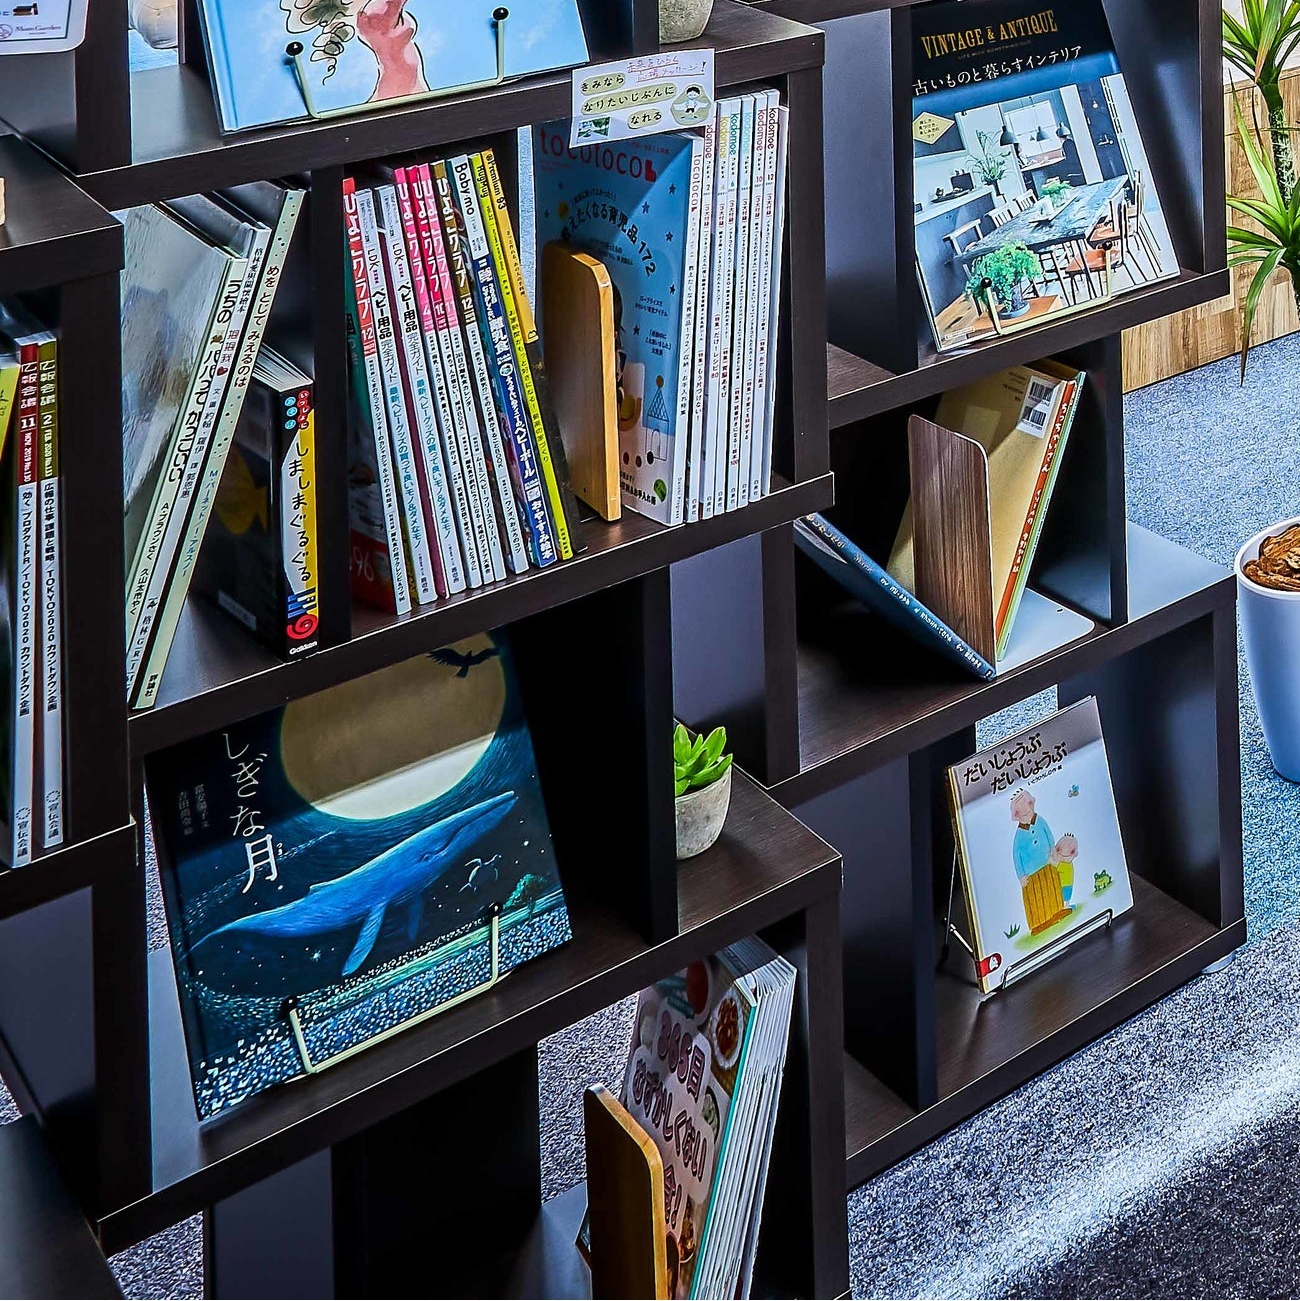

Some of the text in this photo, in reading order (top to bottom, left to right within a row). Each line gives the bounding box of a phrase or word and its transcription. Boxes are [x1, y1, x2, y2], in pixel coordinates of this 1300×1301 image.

[920, 27, 985, 60] VINTAGE
[1000, 8, 1059, 41] ANTIQUE
[580, 75, 624, 92] きみなら
[912, 45, 1082, 97] 古いものと暮らすインテリア
[583, 84, 676, 112] なりたいじぶんに
[630, 111, 662, 124] なれる
[728, 113, 739, 156] kodomoe
[757, 109, 767, 151] kodomoe
[768, 107, 777, 150] kodomoe
[476, 165, 489, 198] HugMug
[496, 197, 507, 210] 93
[392, 242, 403, 265] LDK
[398, 183, 426, 294] ひよこクラブ
[413, 183, 440, 293] ひよこクラブ
[422, 182, 450, 292] ひよこクラブ
[436, 178, 466, 288] ひよこクラブ
[264, 265, 279, 288] めを
[343, 194, 371, 320] ひよこクラブ
[367, 249, 379, 272] LDK
[216, 280, 242, 324] うちの
[253, 292, 272, 326] とじて
[462, 298, 473, 311] 12
[372, 288, 398, 384] ベビー用品 完全ガイド
[398, 281, 423, 375] ベビー用品 完全ガイド
[194, 350, 222, 405] パパって
[234, 330, 261, 388] みえるのは
[21, 418, 36, 428] 11
[43, 414, 53, 426] 2
[1041, 402, 1069, 473] ちっちゃいさん
[288, 442, 310, 582] しましまぐるぐる
[289, 641, 317, 655] Gakken
[46, 644, 58, 713] カウントダウン企画
[963, 732, 1043, 787] だいじょうぶ
[990, 741, 1068, 795] だいじょうぶ
